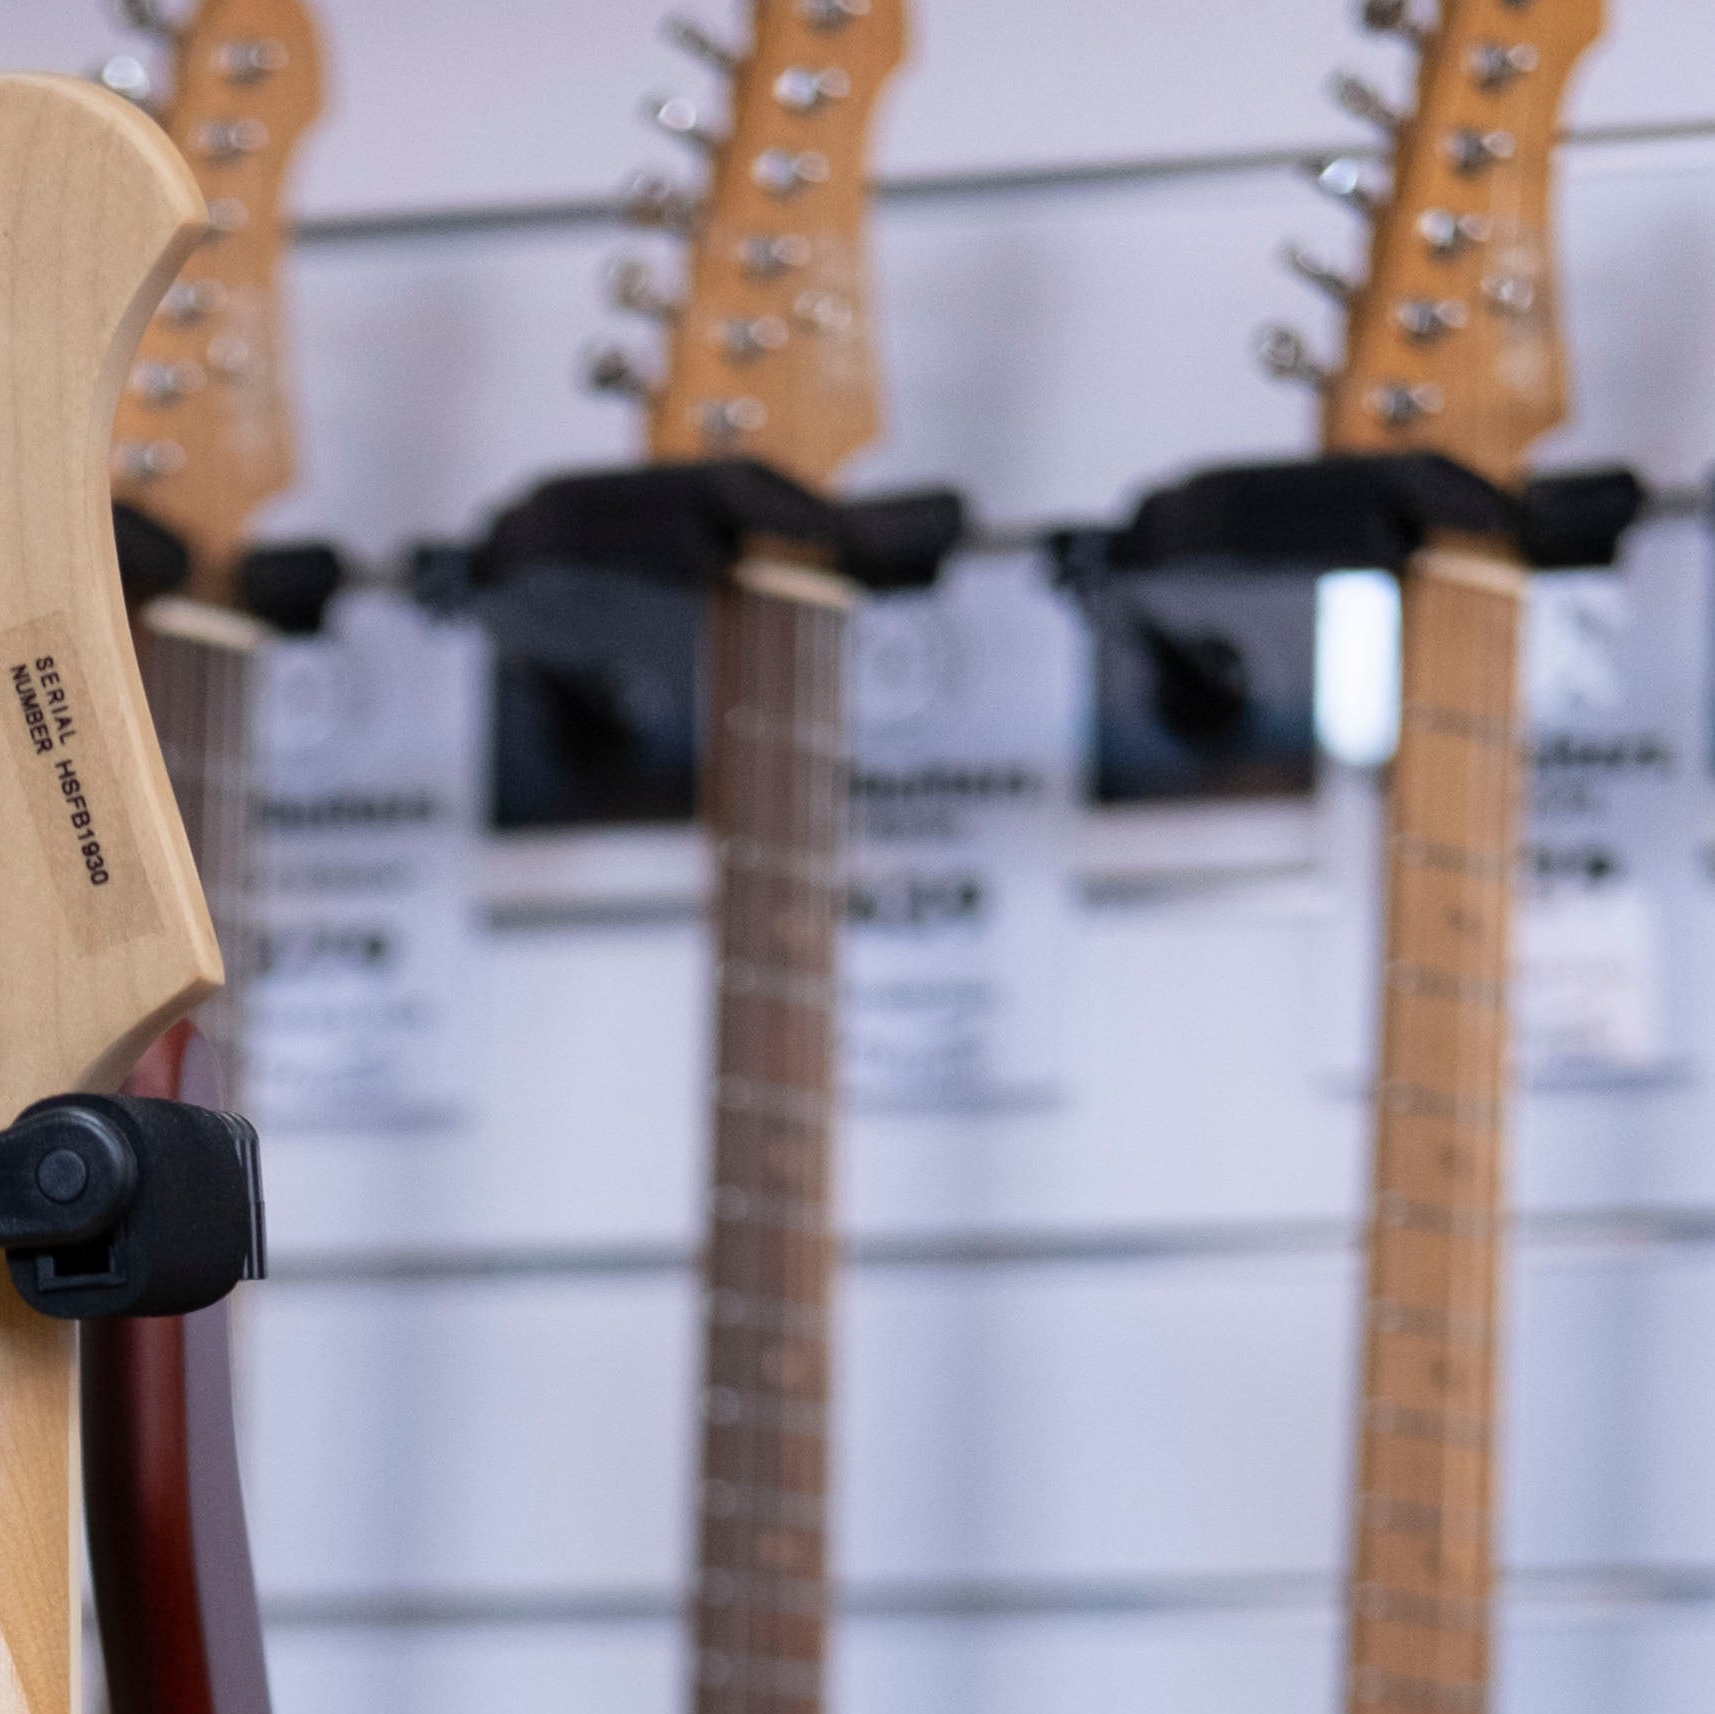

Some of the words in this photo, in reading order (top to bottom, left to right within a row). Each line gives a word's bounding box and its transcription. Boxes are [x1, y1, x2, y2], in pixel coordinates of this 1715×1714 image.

[9, 663, 54, 755] NUMBER
[35, 655, 77, 746] SERIAL
[54, 758, 110, 886] HSFB1930
